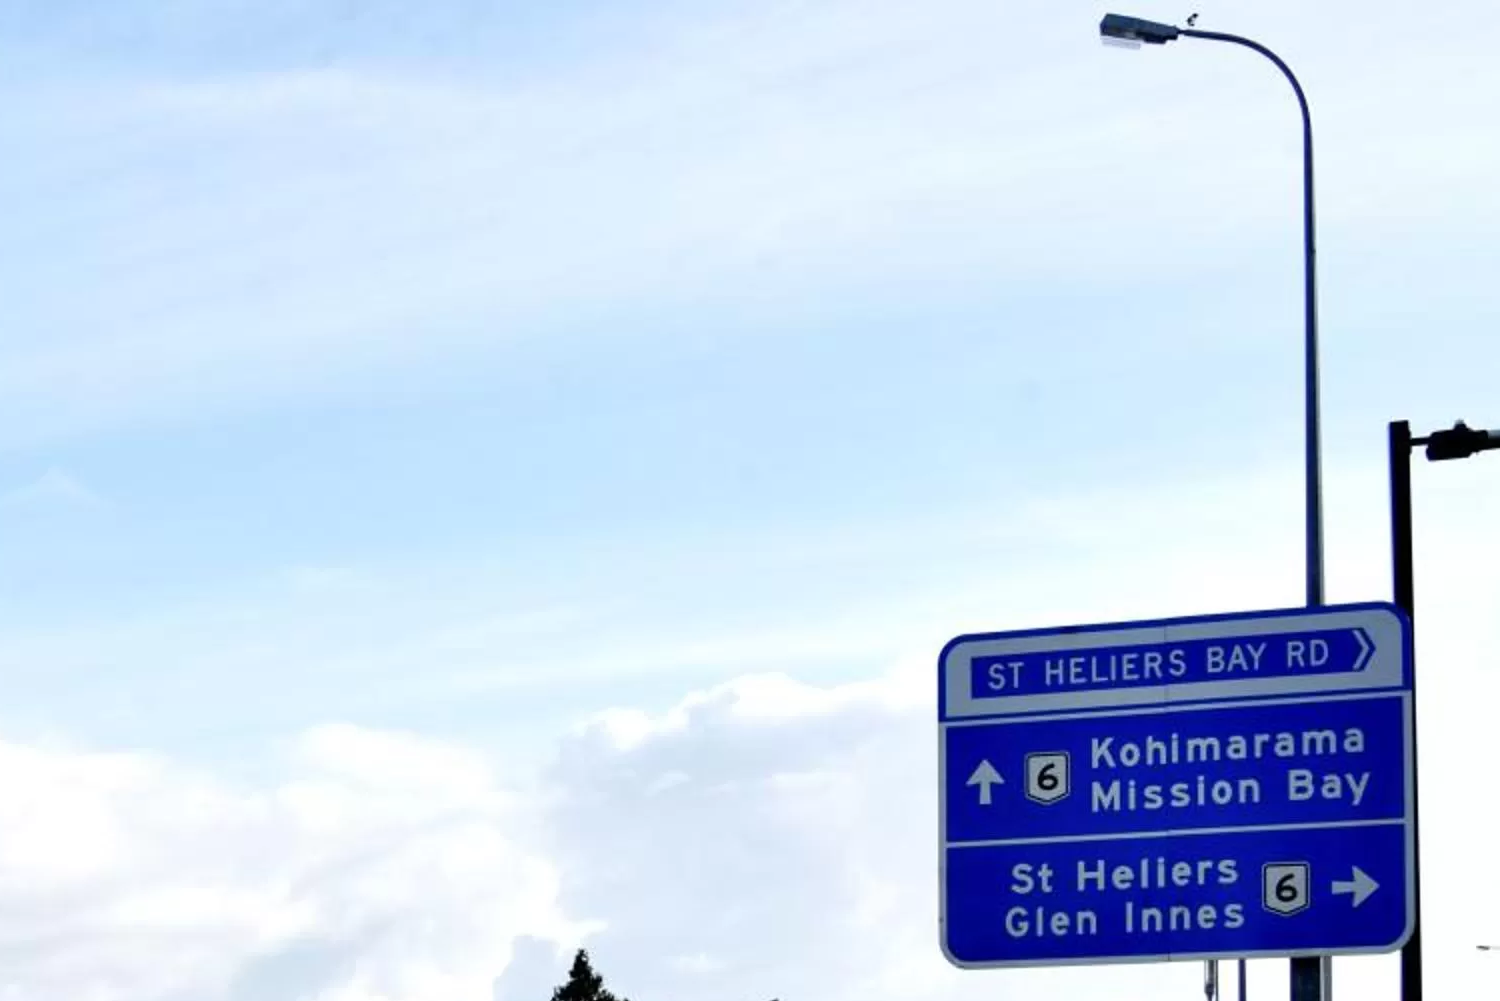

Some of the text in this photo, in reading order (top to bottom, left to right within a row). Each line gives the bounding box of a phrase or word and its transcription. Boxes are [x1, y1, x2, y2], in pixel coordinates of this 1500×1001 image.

[988, 639, 1329, 690] ST HELIERS BAY RD
[1091, 728, 1365, 769] Kohimarama
[1037, 762, 1059, 791] 6
[1091, 768, 1371, 812] Mission Bay
[1010, 857, 1239, 894] St Heliers
[1275, 873, 1299, 902] 6
[1005, 901, 1245, 938] Glen Innes
